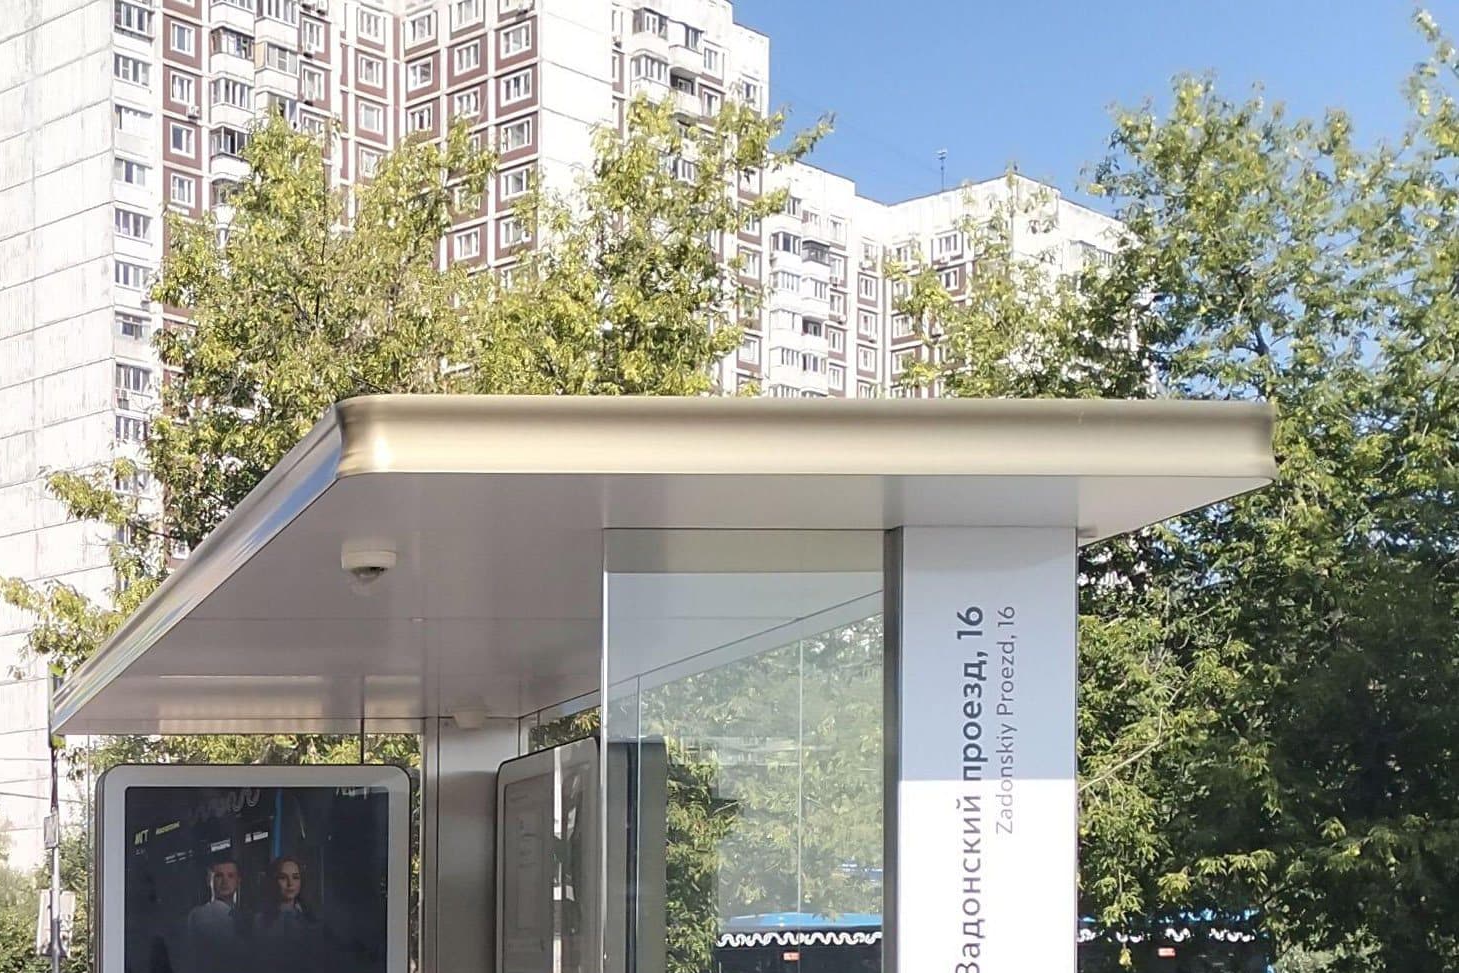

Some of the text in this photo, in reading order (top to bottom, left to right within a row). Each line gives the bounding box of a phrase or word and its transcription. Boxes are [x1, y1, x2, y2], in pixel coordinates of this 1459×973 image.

[957, 606, 983, 640] 16
[963, 651, 988, 781] проезд,
[996, 606, 1017, 834] Zadonskiy Proezd, 16
